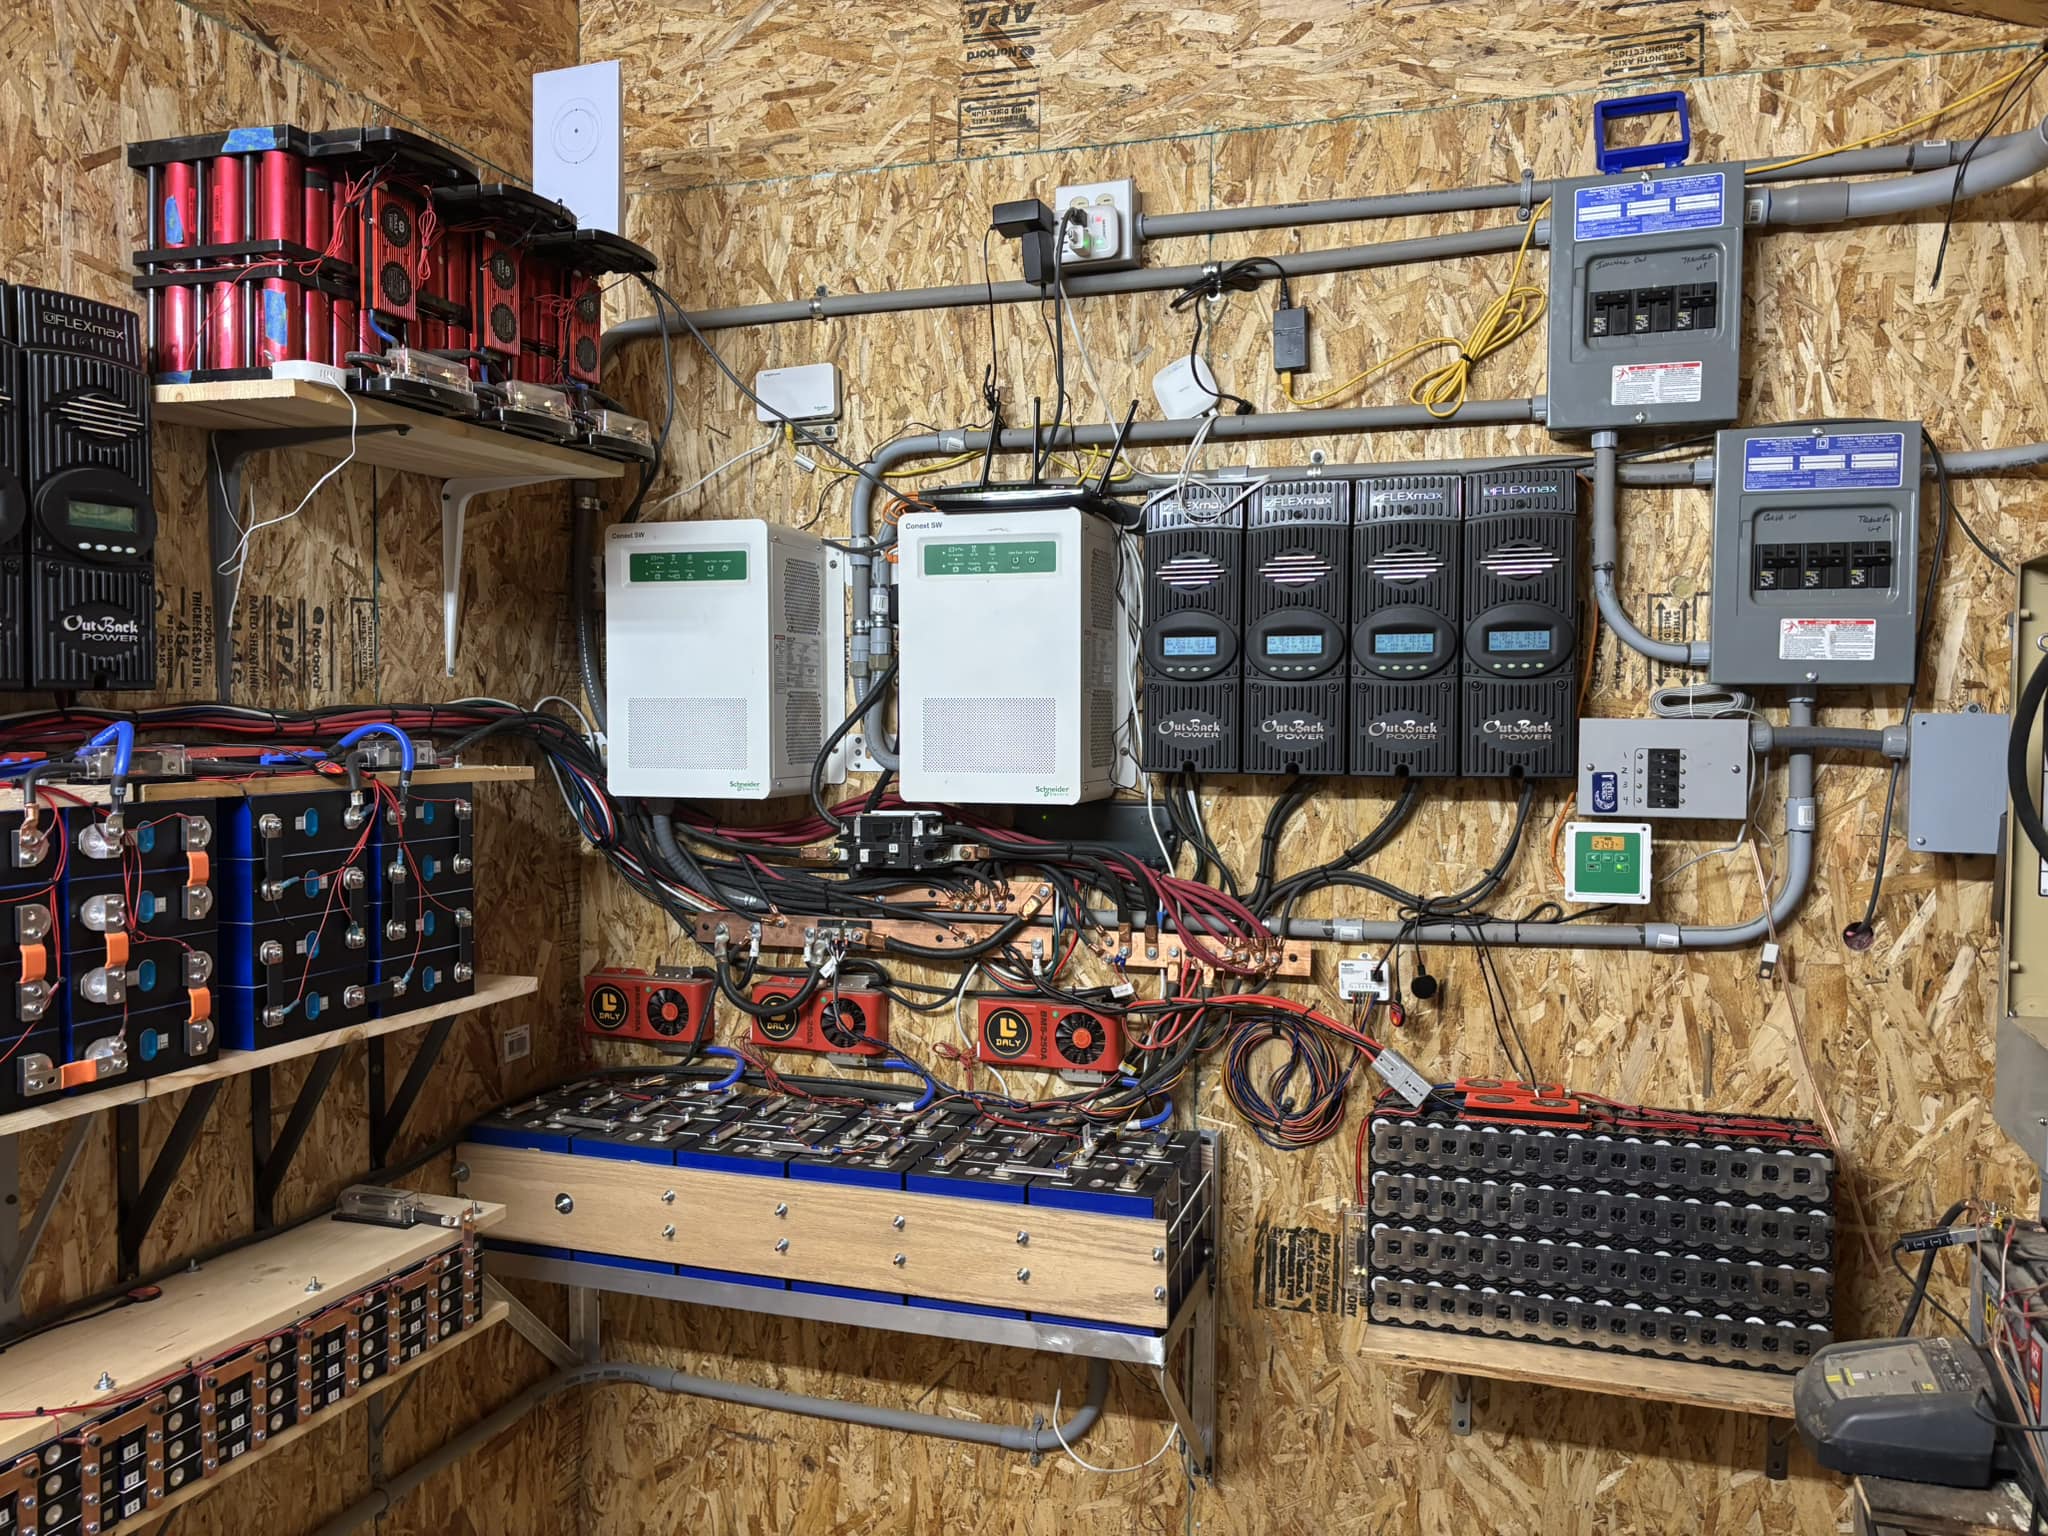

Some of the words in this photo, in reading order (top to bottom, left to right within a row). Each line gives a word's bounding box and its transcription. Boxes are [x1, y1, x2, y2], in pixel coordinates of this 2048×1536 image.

[967, 1, 1036, 29] APA
[966, 45, 1017, 62] Norbord
[1636, 51, 1686, 64] STRENGTH
[1612, 58, 1635, 68] AXIS
[55, 314, 125, 340] FLEXmax
[1383, 491, 1443, 501] FLEXmax
[1494, 484, 1557, 496] FLEXmax
[1272, 497, 1332, 507] FLEXmax
[905, 521, 930, 530] Conext
[931, 520, 943, 528] SW
[191, 591, 203, 645] THICKNESS
[249, 595, 258, 630] RATED
[63, 615, 138, 633] OutBack
[81, 633, 139, 642] POWER
[203, 605, 212, 667] EXPOSURE
[275, 603, 294, 688] APA
[311, 628, 322, 689] Norbord
[1158, 718, 1220, 735] OutBack
[1262, 719, 1324, 734] OutBack
[1368, 719, 1437, 736] OutBack
[1483, 719, 1553, 734] OutBack
[1174, 731, 1219, 739] POWER
[1499, 733, 1552, 741] POWER
[1035, 785, 1070, 797] Schneider
[766, 1022, 791, 1031] DALY
[995, 1038, 1022, 1047] DALY
[1040, 1011, 1048, 1060] BMS-250A
